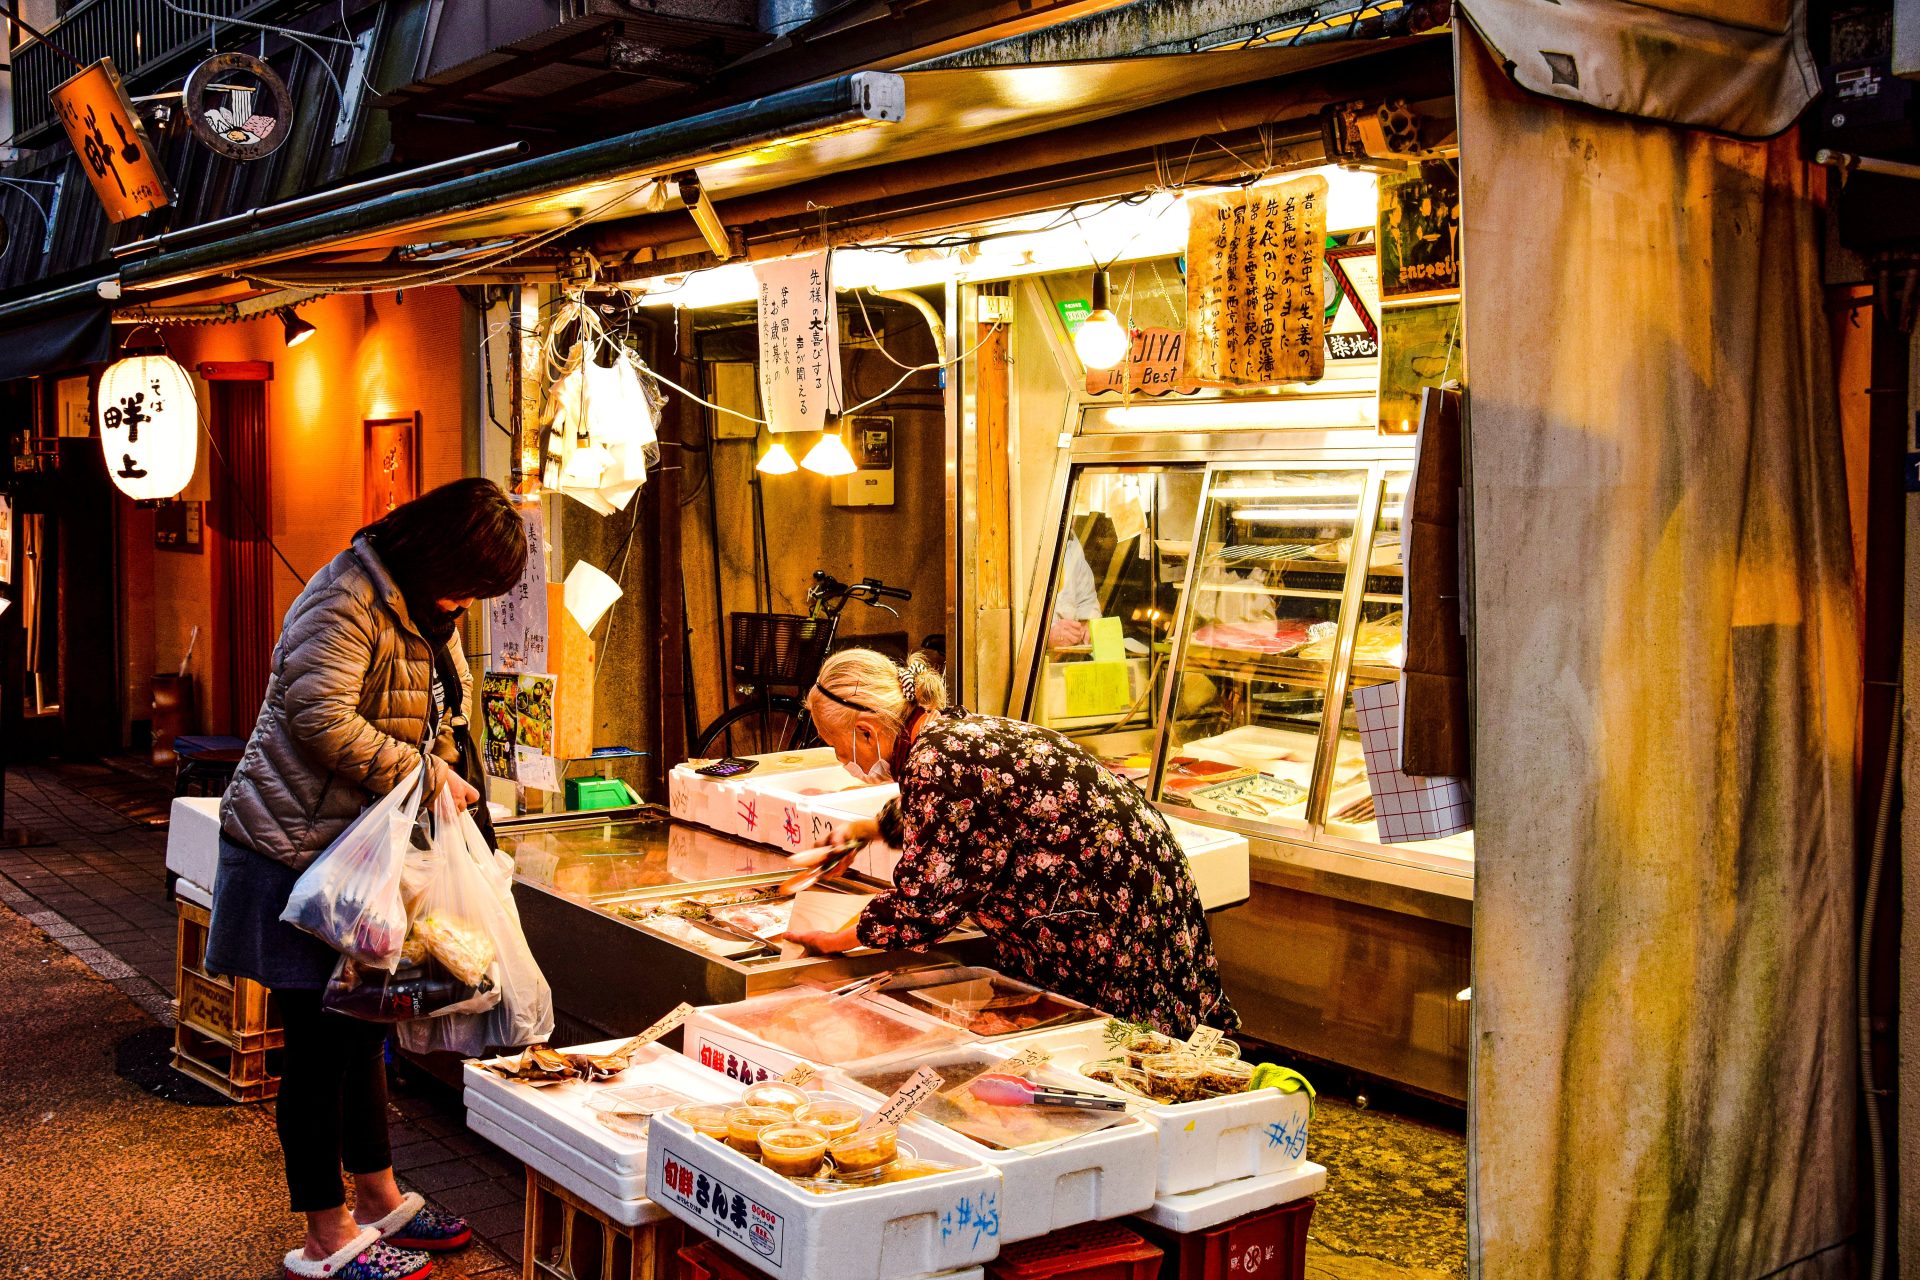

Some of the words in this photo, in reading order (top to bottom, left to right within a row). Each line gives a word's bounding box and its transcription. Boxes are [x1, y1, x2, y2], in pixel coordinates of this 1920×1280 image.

[83, 103, 141, 198] 畔上
[769, 299, 782, 382] お歳暮の
[808, 269, 824, 390] 先様の大喜びする
[1130, 332, 1181, 363] JIYA
[150, 378, 165, 413] そば
[796, 334, 808, 416] 声が聞える
[1108, 369, 1131, 385] Th
[1142, 366, 1178, 385] Best
[103, 392, 152, 479] 畔上
[528, 522, 540, 583] 美味しい
